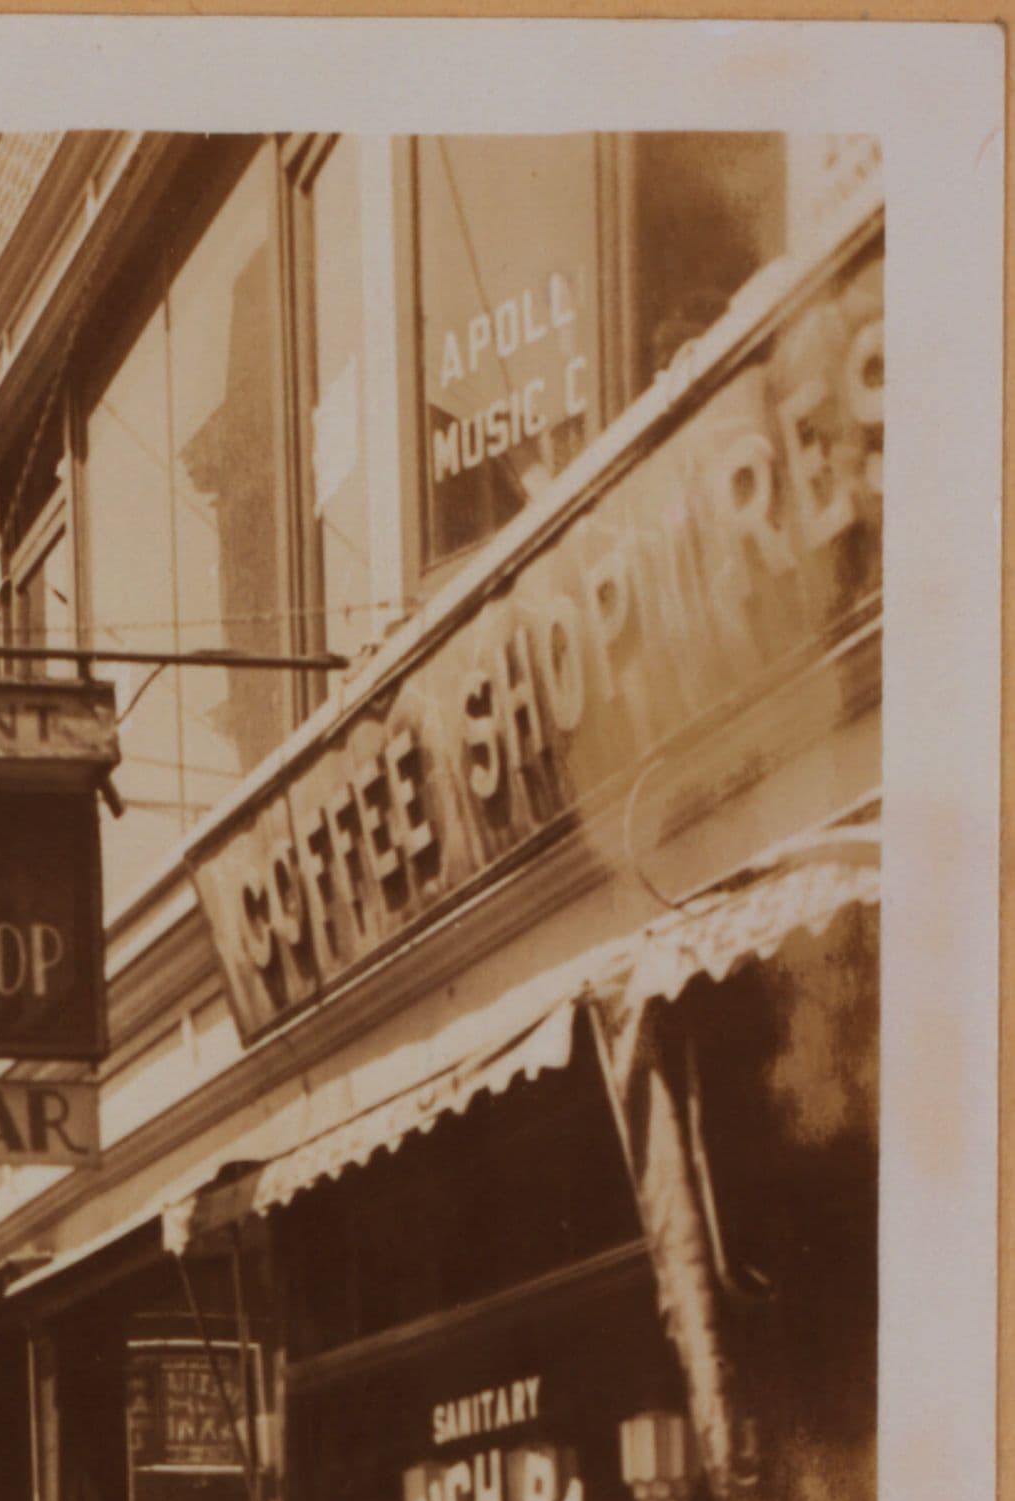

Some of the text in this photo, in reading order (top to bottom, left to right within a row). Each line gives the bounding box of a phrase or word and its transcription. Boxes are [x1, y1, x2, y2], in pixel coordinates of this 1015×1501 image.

[433, 377, 547, 484] MUSIC
[237, 726, 435, 970] COFFEE
[465, 550, 629, 799] SHOP
[432, 1376, 542, 1446] SANITARY
